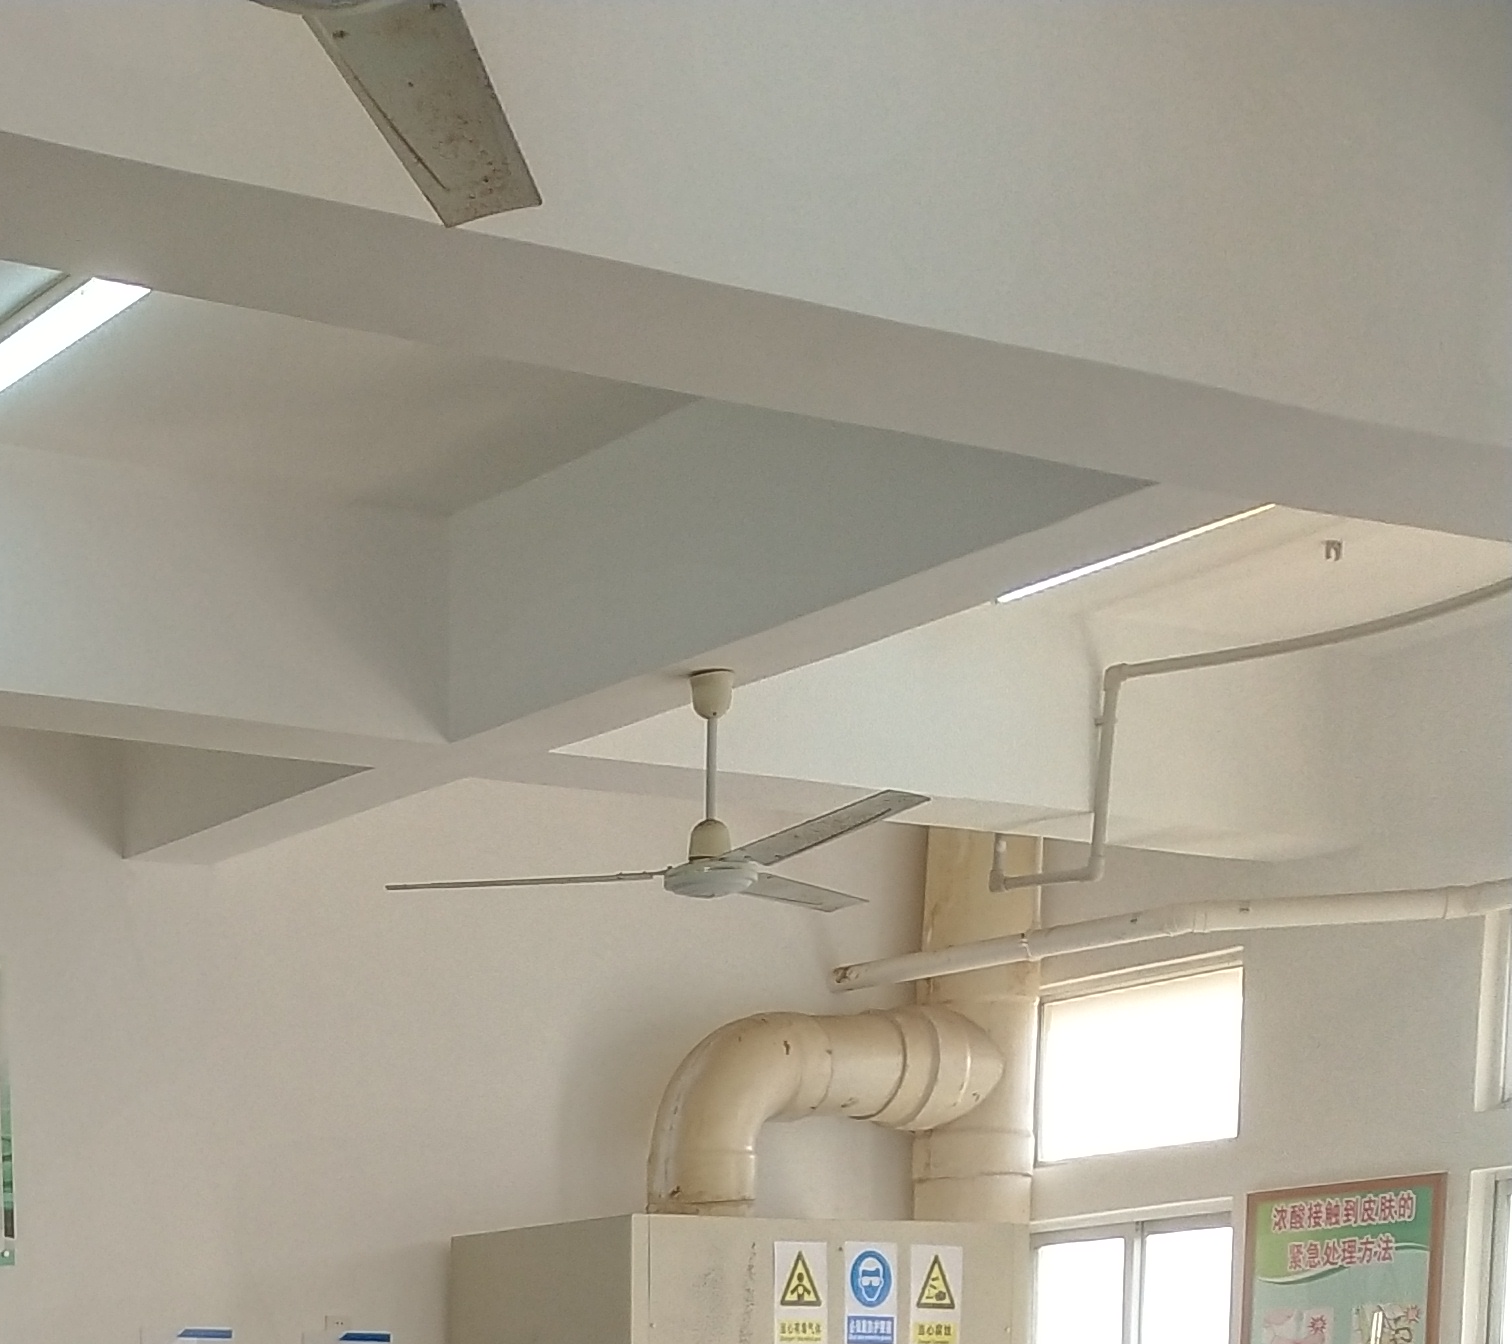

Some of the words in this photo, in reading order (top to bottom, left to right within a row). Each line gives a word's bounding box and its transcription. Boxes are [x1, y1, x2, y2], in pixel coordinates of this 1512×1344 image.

[1272, 1191, 1416, 1232] 浓酸接触到皮肤的
[1288, 1234, 1394, 1270] 紧急处理方法
